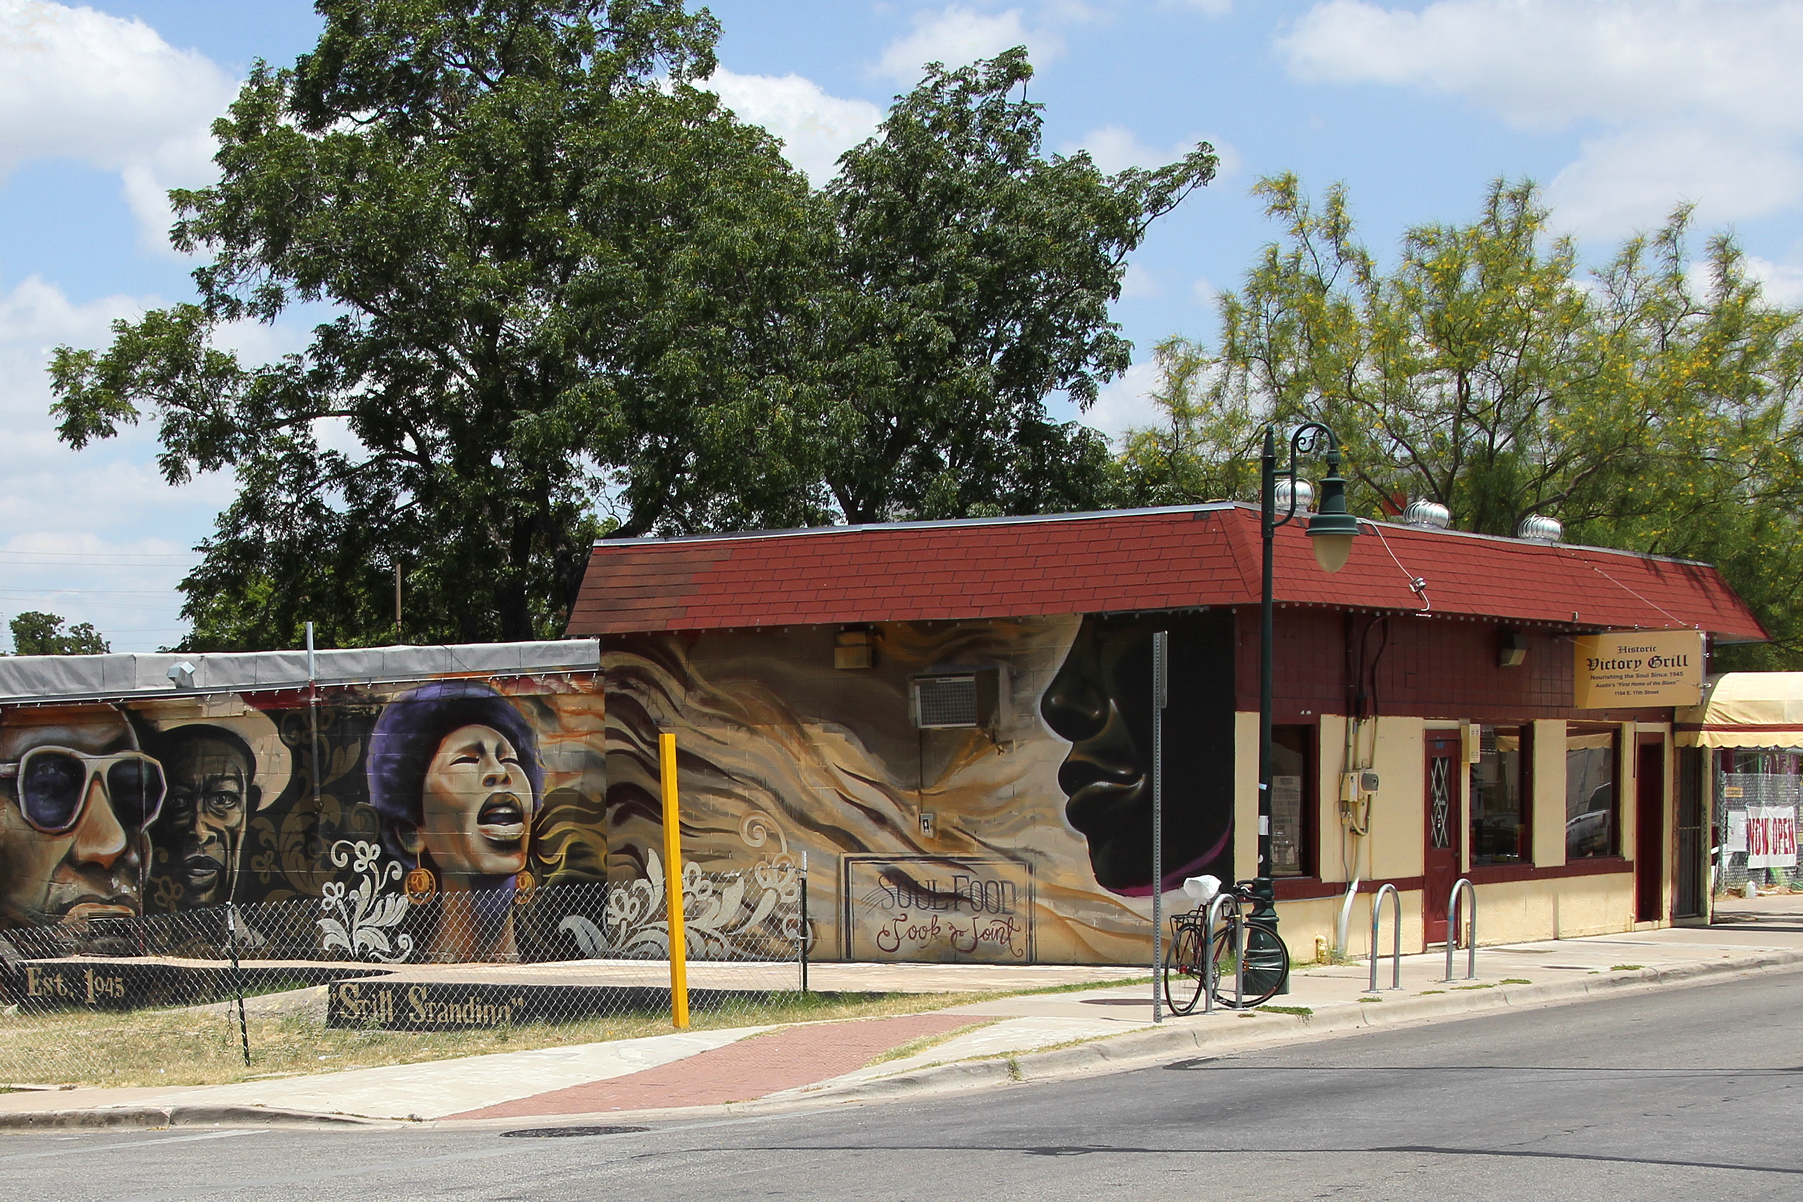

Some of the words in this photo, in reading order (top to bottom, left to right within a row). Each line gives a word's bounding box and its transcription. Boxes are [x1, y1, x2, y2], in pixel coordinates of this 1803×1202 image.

[1586, 657, 1642, 671] Victory
[1648, 654, 1688, 668] Grill
[1617, 645, 1657, 654] Historic
[1773, 818, 1796, 855] OPEN
[878, 874, 949, 911] SOUL
[952, 875, 1017, 914] FOOD
[25, 966, 74, 997] Est.
[83, 968, 125, 1003] 1945
